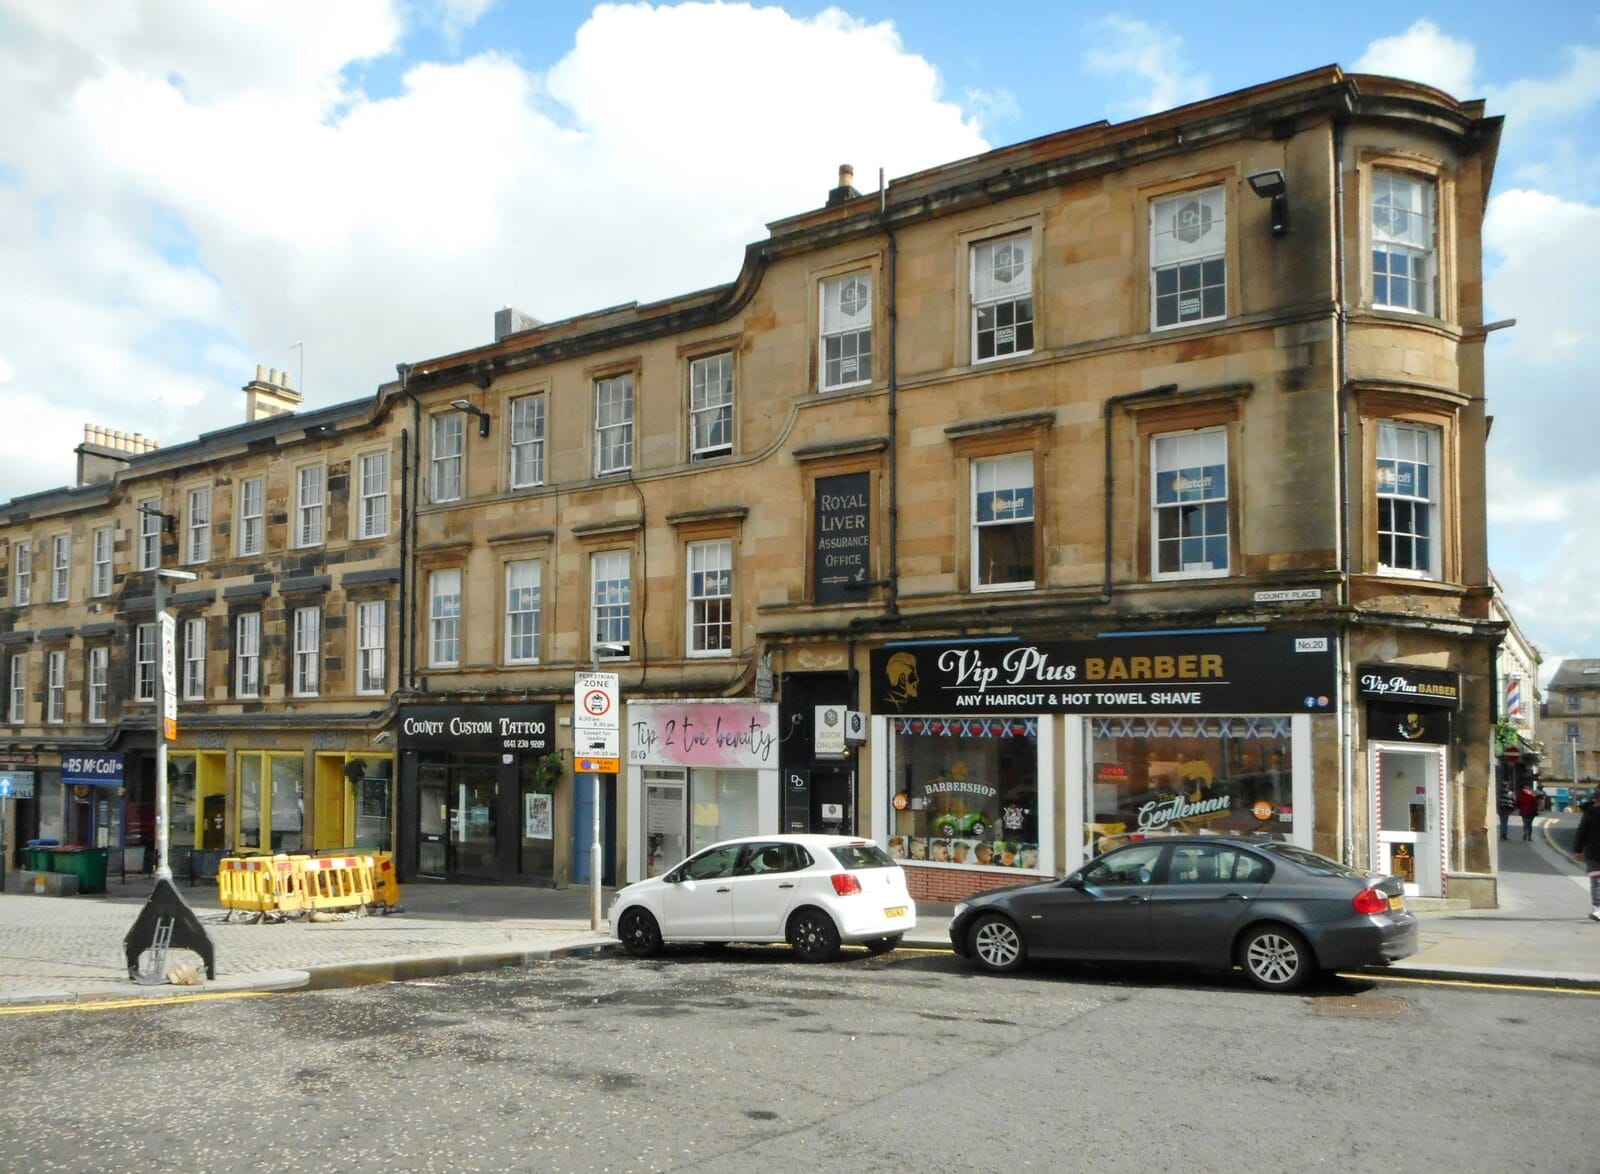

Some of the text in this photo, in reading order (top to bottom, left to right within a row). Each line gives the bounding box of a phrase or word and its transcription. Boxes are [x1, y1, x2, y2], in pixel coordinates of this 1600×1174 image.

[821, 494, 867, 512] ROYAL
[821, 515, 865, 532] LIVER
[818, 535, 869, 550] ASSURANCE
[825, 554, 862, 567] OFFICE
[1258, 590, 1317, 600] COUNTY PLACE
[1297, 640, 1324, 649] No.20
[937, 646, 1224, 693] Vip Plus BARBER
[583, 680, 609, 688] ZONE
[1361, 674, 1456, 696] Vip Plus BARBER
[956, 691, 1201, 706] ANY HAIRCUT & HOT TOWEL SHAVE
[404, 717, 545, 736] COUNTY CUSTOM TATTOO
[665, 720, 676, 745] 2
[716, 715, 777, 762] beauty
[820, 731, 841, 739] BOOK
[68, 759, 116, 773] RS McColl
[925, 782, 997, 797] BARBERSHOP
[1137, 795, 1231, 833] Gentleman
